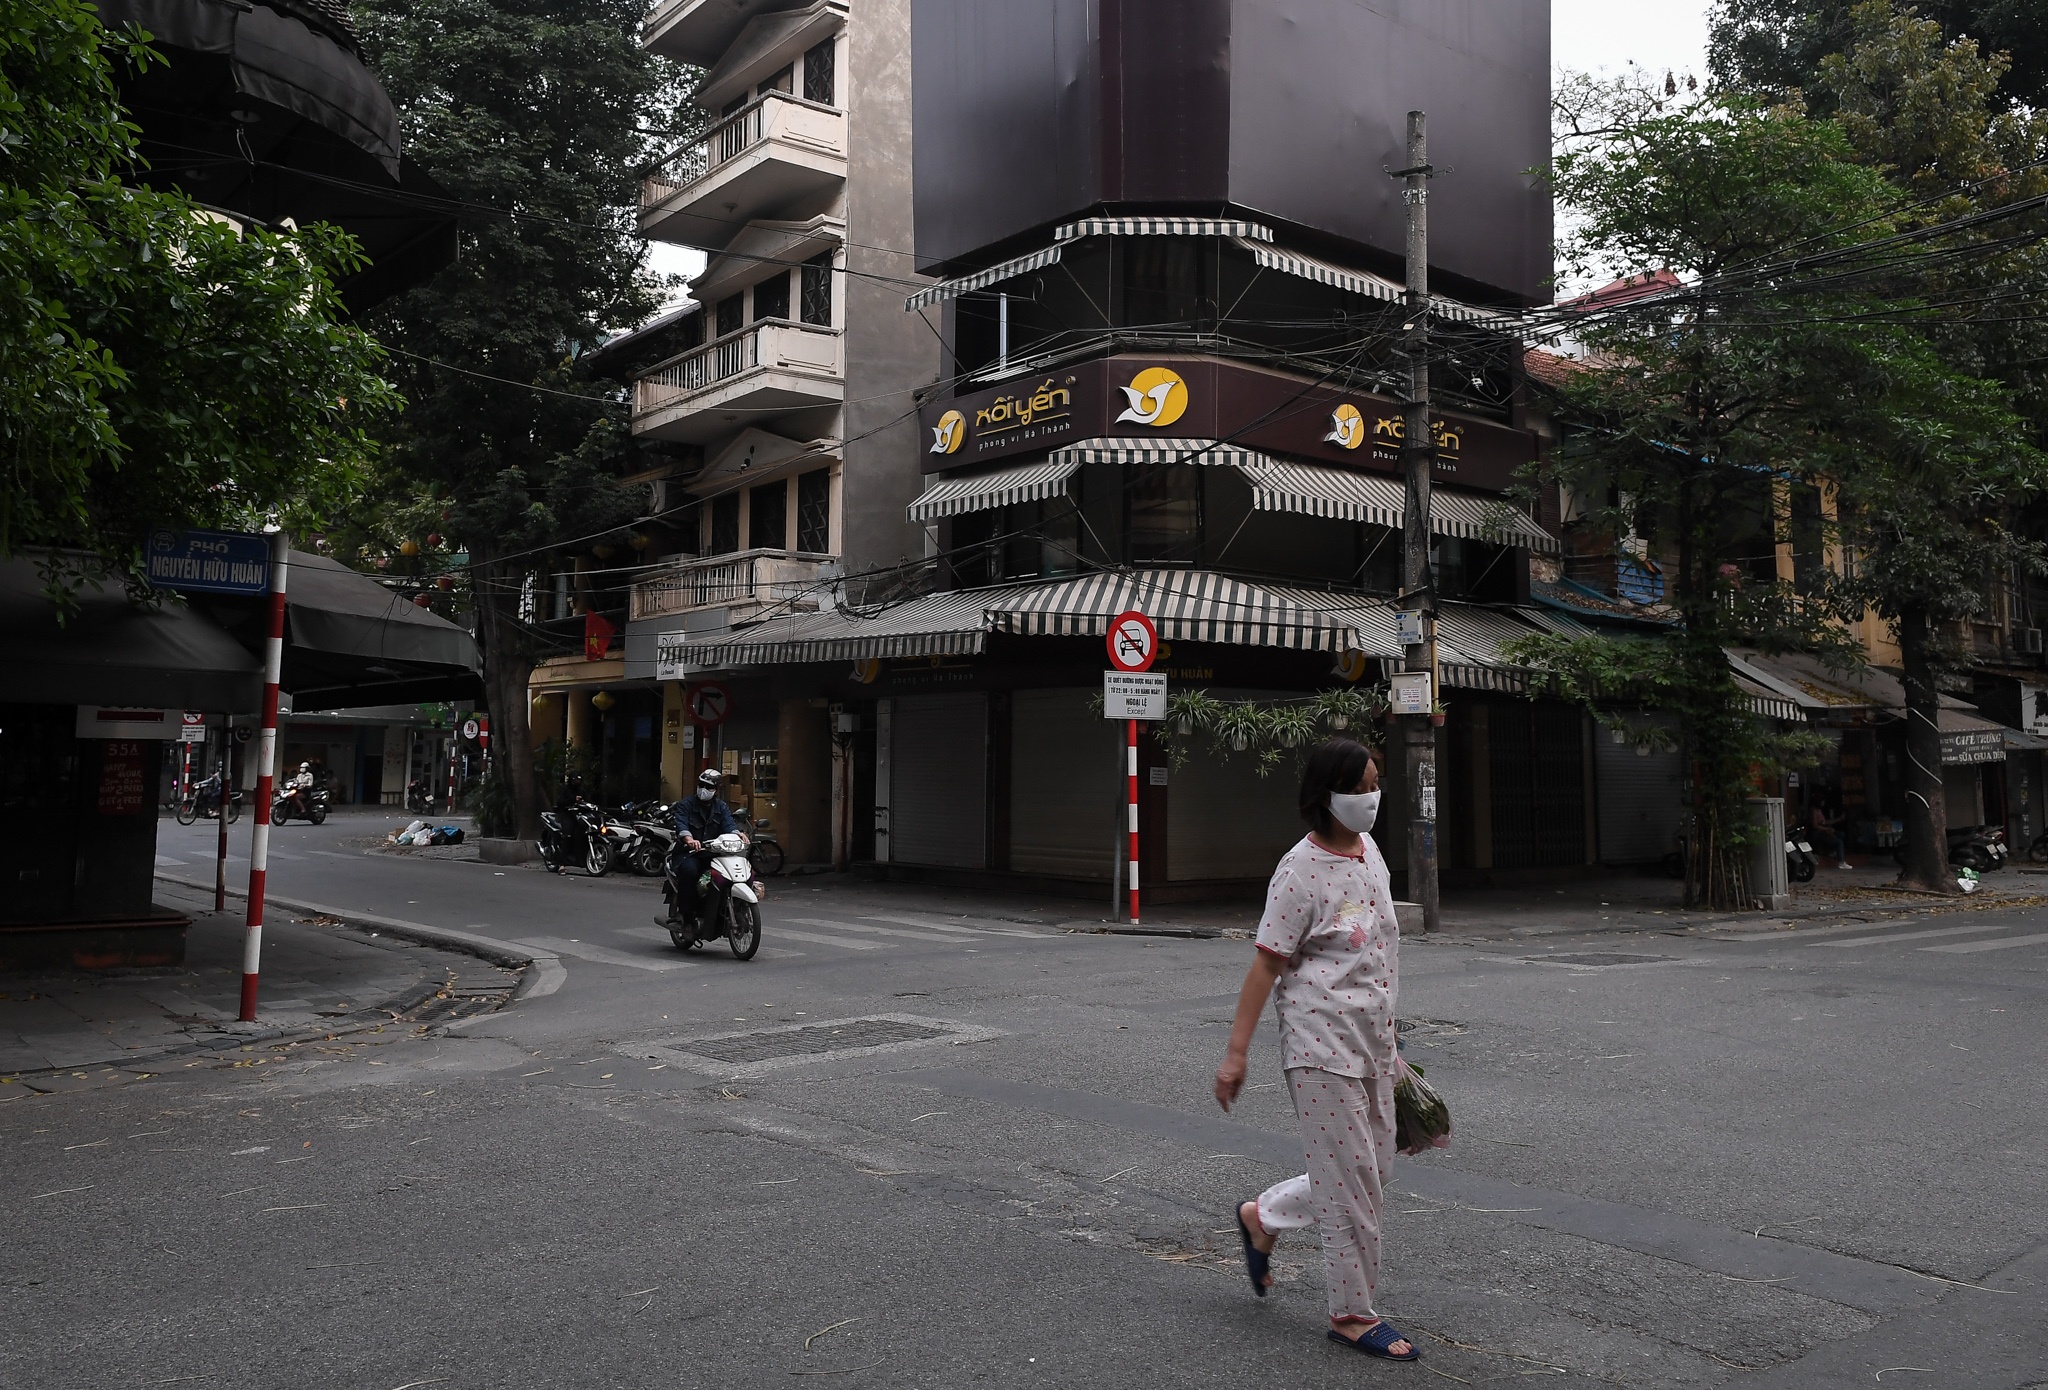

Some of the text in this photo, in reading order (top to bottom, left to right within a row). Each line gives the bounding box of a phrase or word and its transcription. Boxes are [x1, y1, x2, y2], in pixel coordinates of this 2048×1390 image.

[979, 438, 1006, 452] phong
[1041, 422, 1070, 435] Thành
[1436, 461, 1457, 472] hành
[190, 538, 230, 554] PHỐ
[152, 551, 263, 584] NGUYỄN HỮU HUÂN
[1180, 665, 1214, 679] HUÂN
[1126, 697, 1148, 707] NGOẠI LỆ
[1127, 708, 1147, 716] Except
[1955, 732, 1976, 746] CAFÉ
[108, 743, 140, 756] 35A
[103, 762, 128, 773] HAPPY
[117, 770, 143, 778] HOUR
[115, 785, 123, 795] 2
[98, 795, 143, 810] GET 1 FREE
